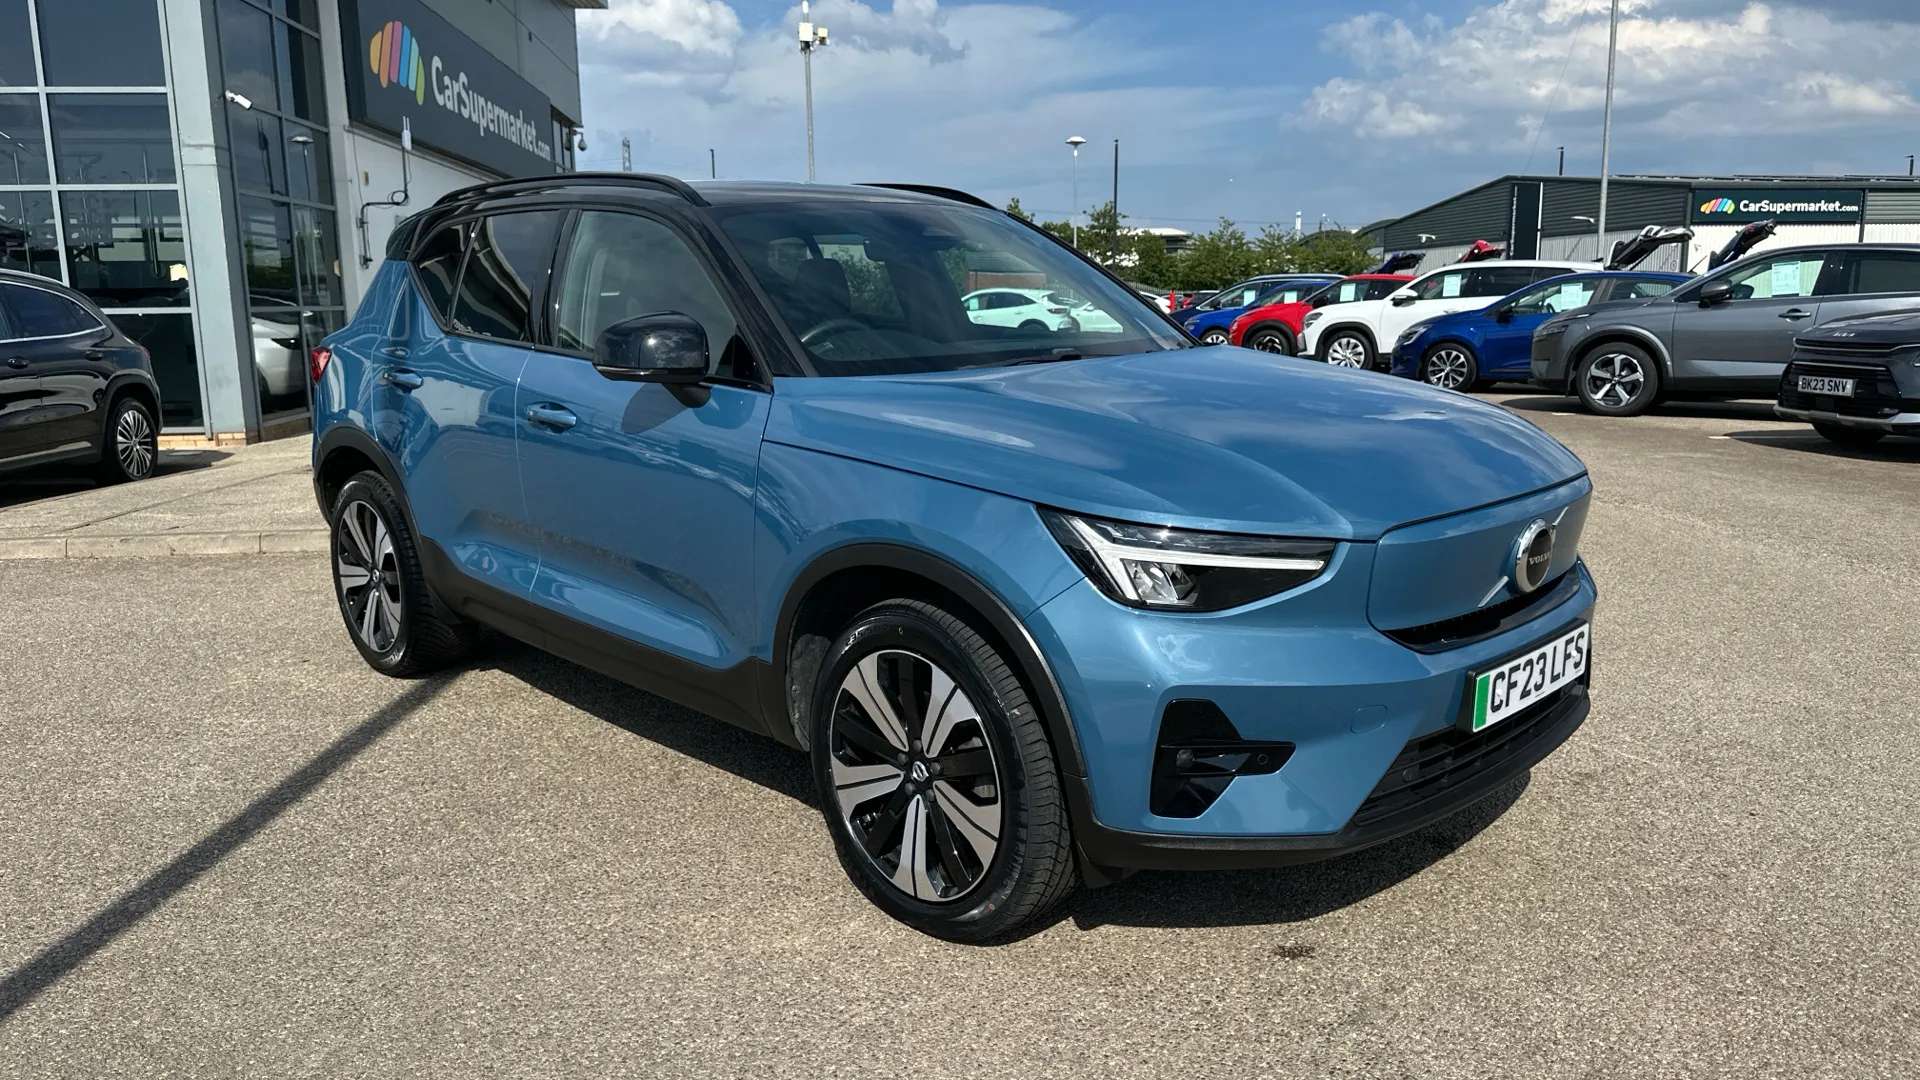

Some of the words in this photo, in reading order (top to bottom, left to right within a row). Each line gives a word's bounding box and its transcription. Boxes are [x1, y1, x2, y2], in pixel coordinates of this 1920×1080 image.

[431, 56, 550, 159] CarSupermarket.com
[1739, 199, 1859, 214] CarSupermarket.com
[1801, 377, 1825, 391] BK23
[1490, 651, 1547, 713] CF23
[1549, 631, 1585, 684] LFS
